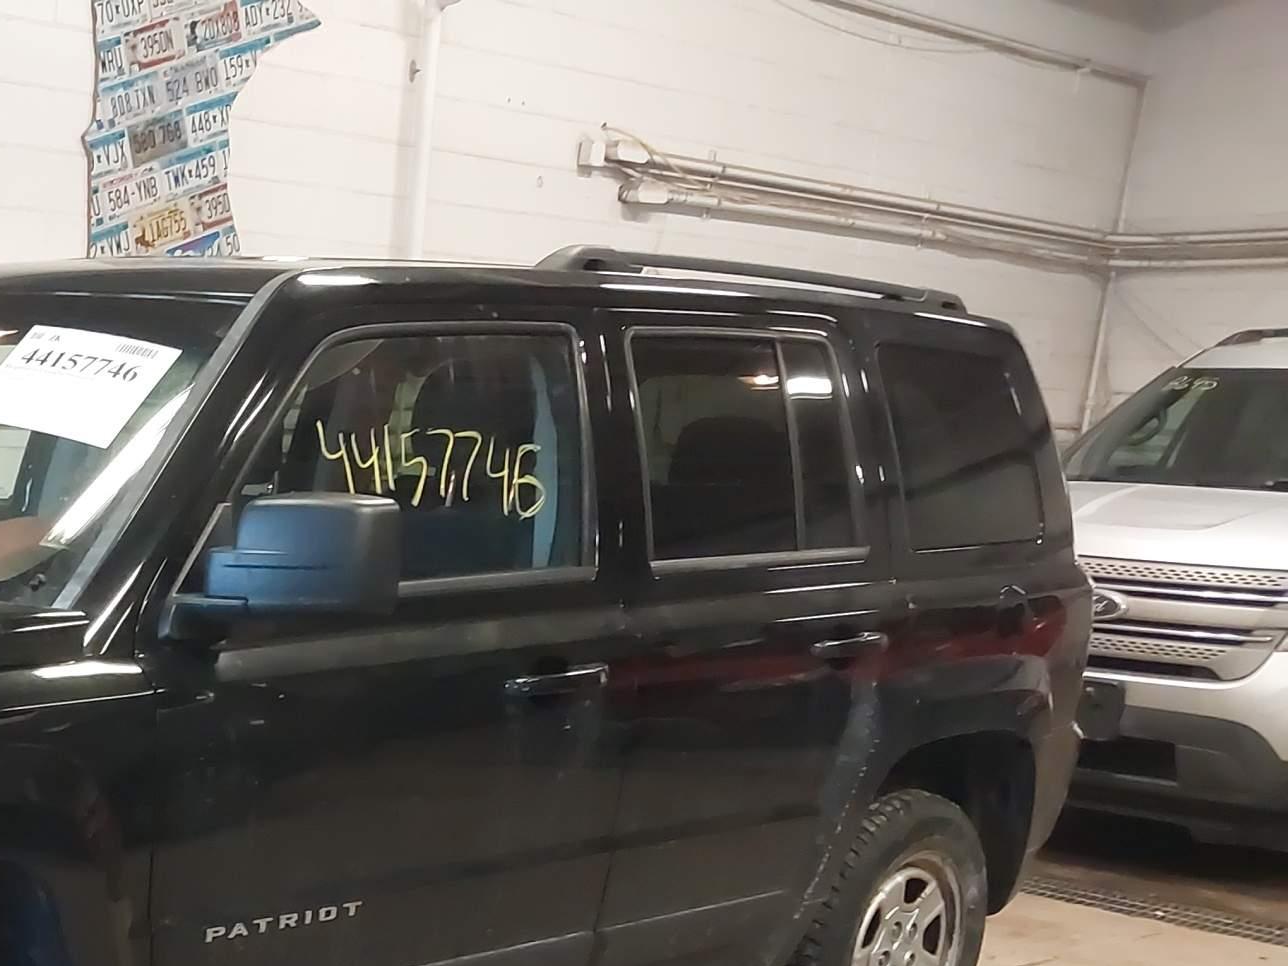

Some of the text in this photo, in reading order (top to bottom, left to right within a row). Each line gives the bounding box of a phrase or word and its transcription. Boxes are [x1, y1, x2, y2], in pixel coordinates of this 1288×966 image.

[21, 348, 143, 382] 44157746
[316, 418, 547, 520] 44157746
[204, 900, 363, 943] PATRIOT
